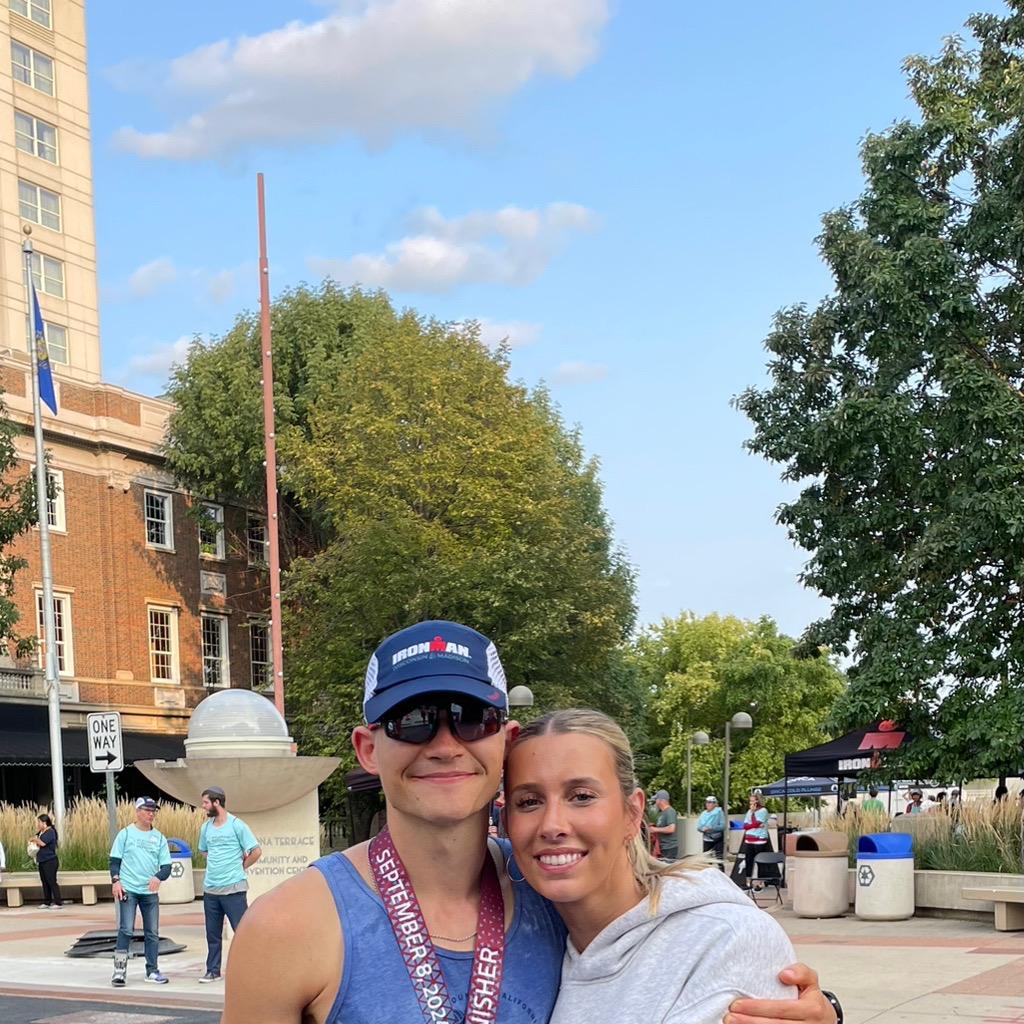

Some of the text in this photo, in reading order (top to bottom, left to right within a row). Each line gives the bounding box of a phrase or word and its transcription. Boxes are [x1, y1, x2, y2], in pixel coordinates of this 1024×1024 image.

[392, 635, 472, 665] IRONMAN
[92, 720, 116, 733] ONE
[93, 734, 118, 749] WAY
[274, 837, 314, 846] TERRACE
[257, 856, 291, 864] MUNITY
[250, 867, 285, 875] VENTION
[376, 848, 426, 961] SEPTEMBER
[415, 962, 432, 983] 8,
